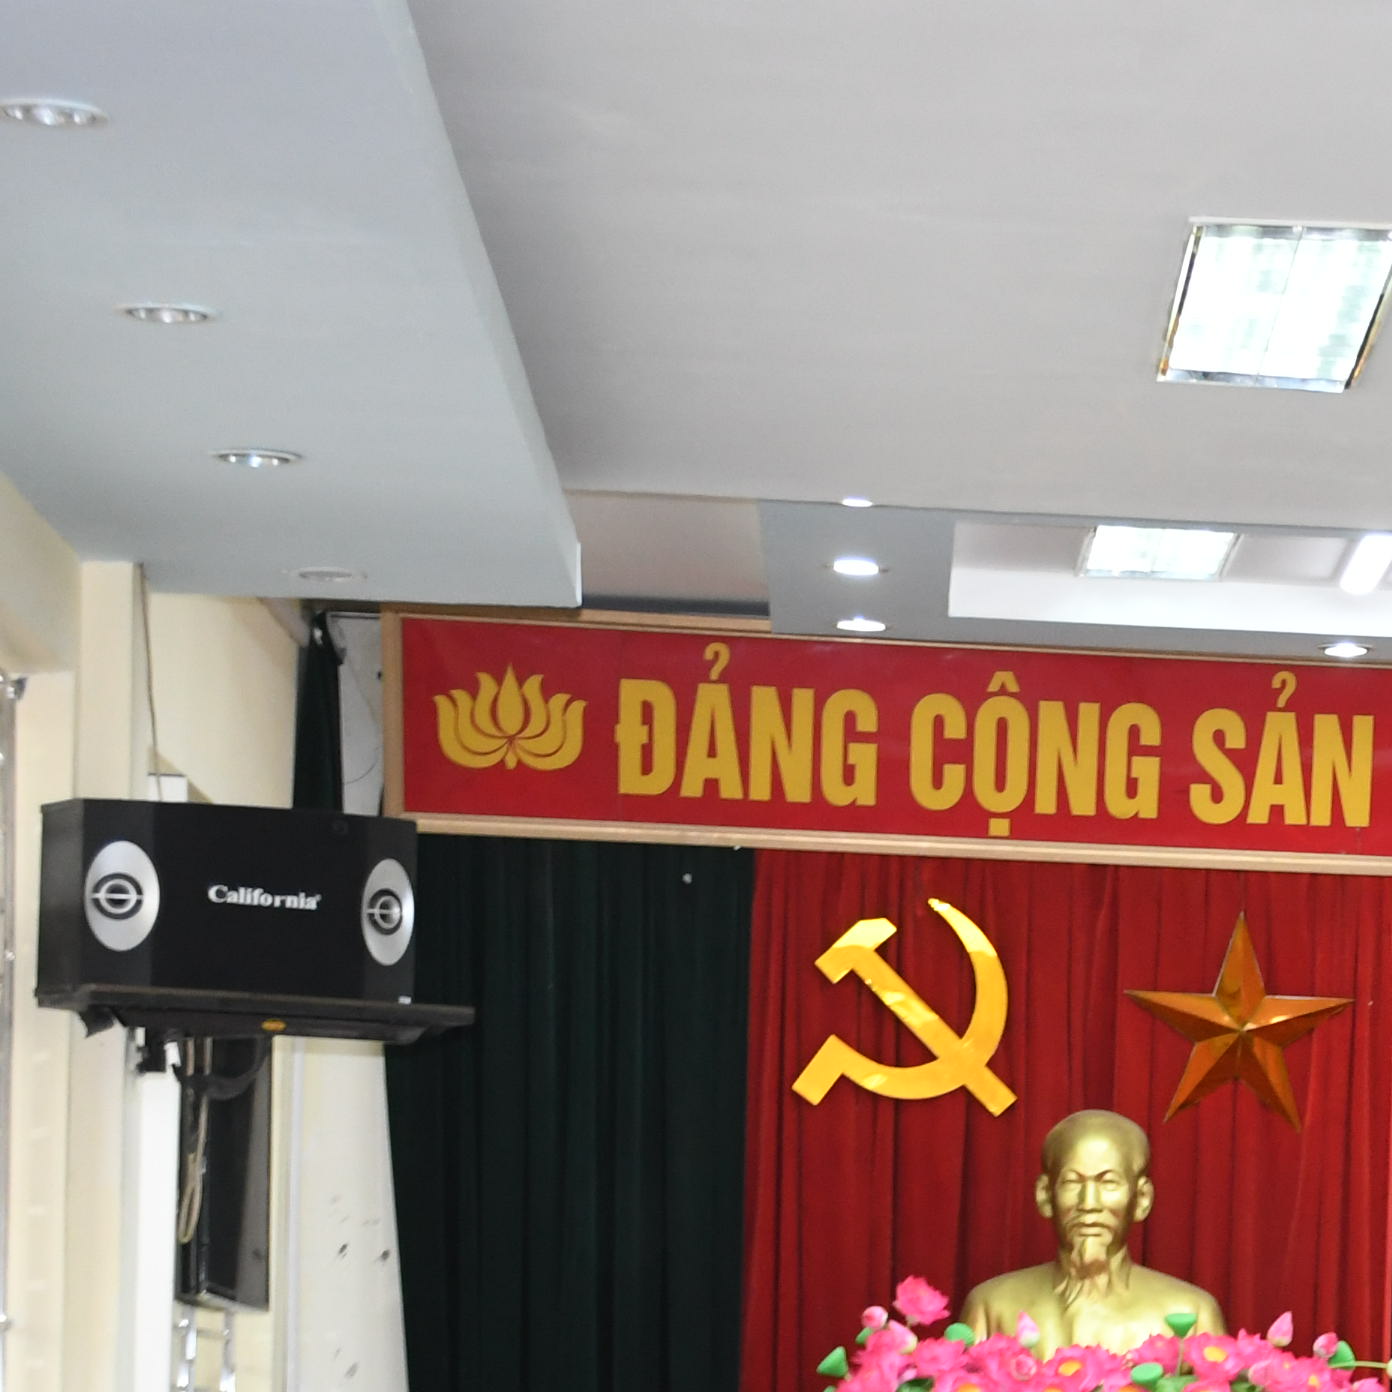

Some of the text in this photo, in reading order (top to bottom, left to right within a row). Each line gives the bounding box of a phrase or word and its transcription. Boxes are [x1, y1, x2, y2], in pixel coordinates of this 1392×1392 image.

[617, 642, 877, 806] ĐẢNG
[911, 671, 1161, 836] CỘNG
[1190, 671, 1373, 829] SẢN
